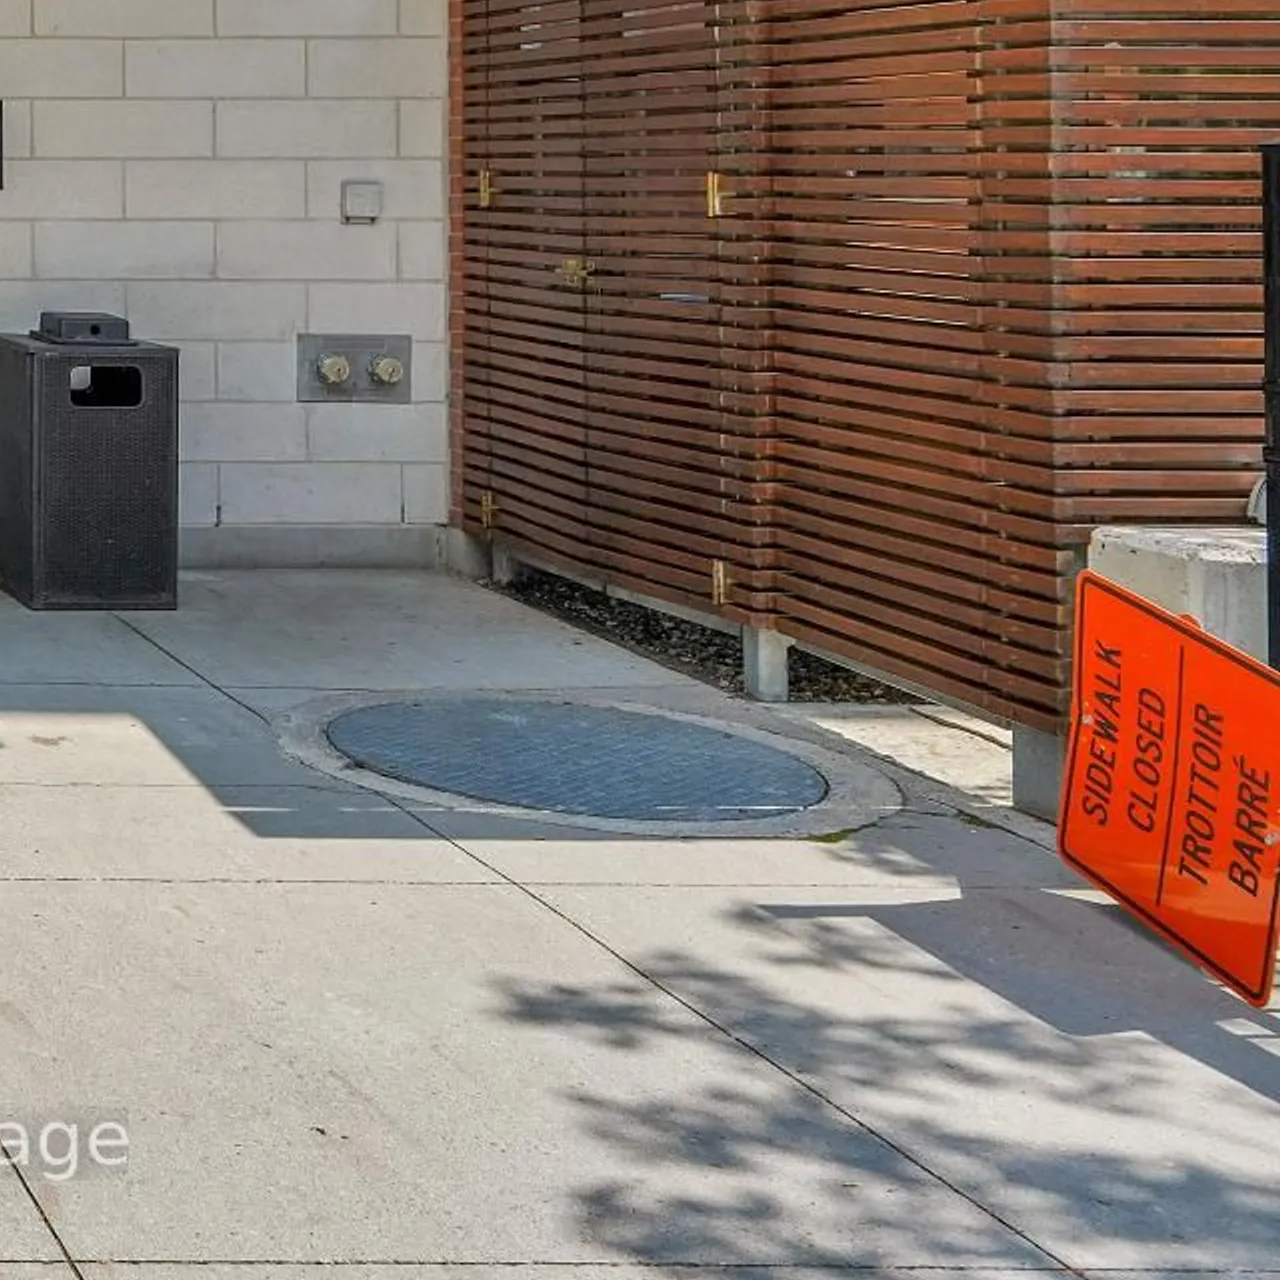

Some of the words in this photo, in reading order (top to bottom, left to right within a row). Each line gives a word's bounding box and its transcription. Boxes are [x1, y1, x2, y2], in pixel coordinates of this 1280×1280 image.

[1081, 640, 1122, 827] SIDEWALK
[1126, 687, 1166, 834] CLOSED
[1177, 703, 1225, 886] TROTTOIR
[1227, 754, 1270, 898] BARRÉ
